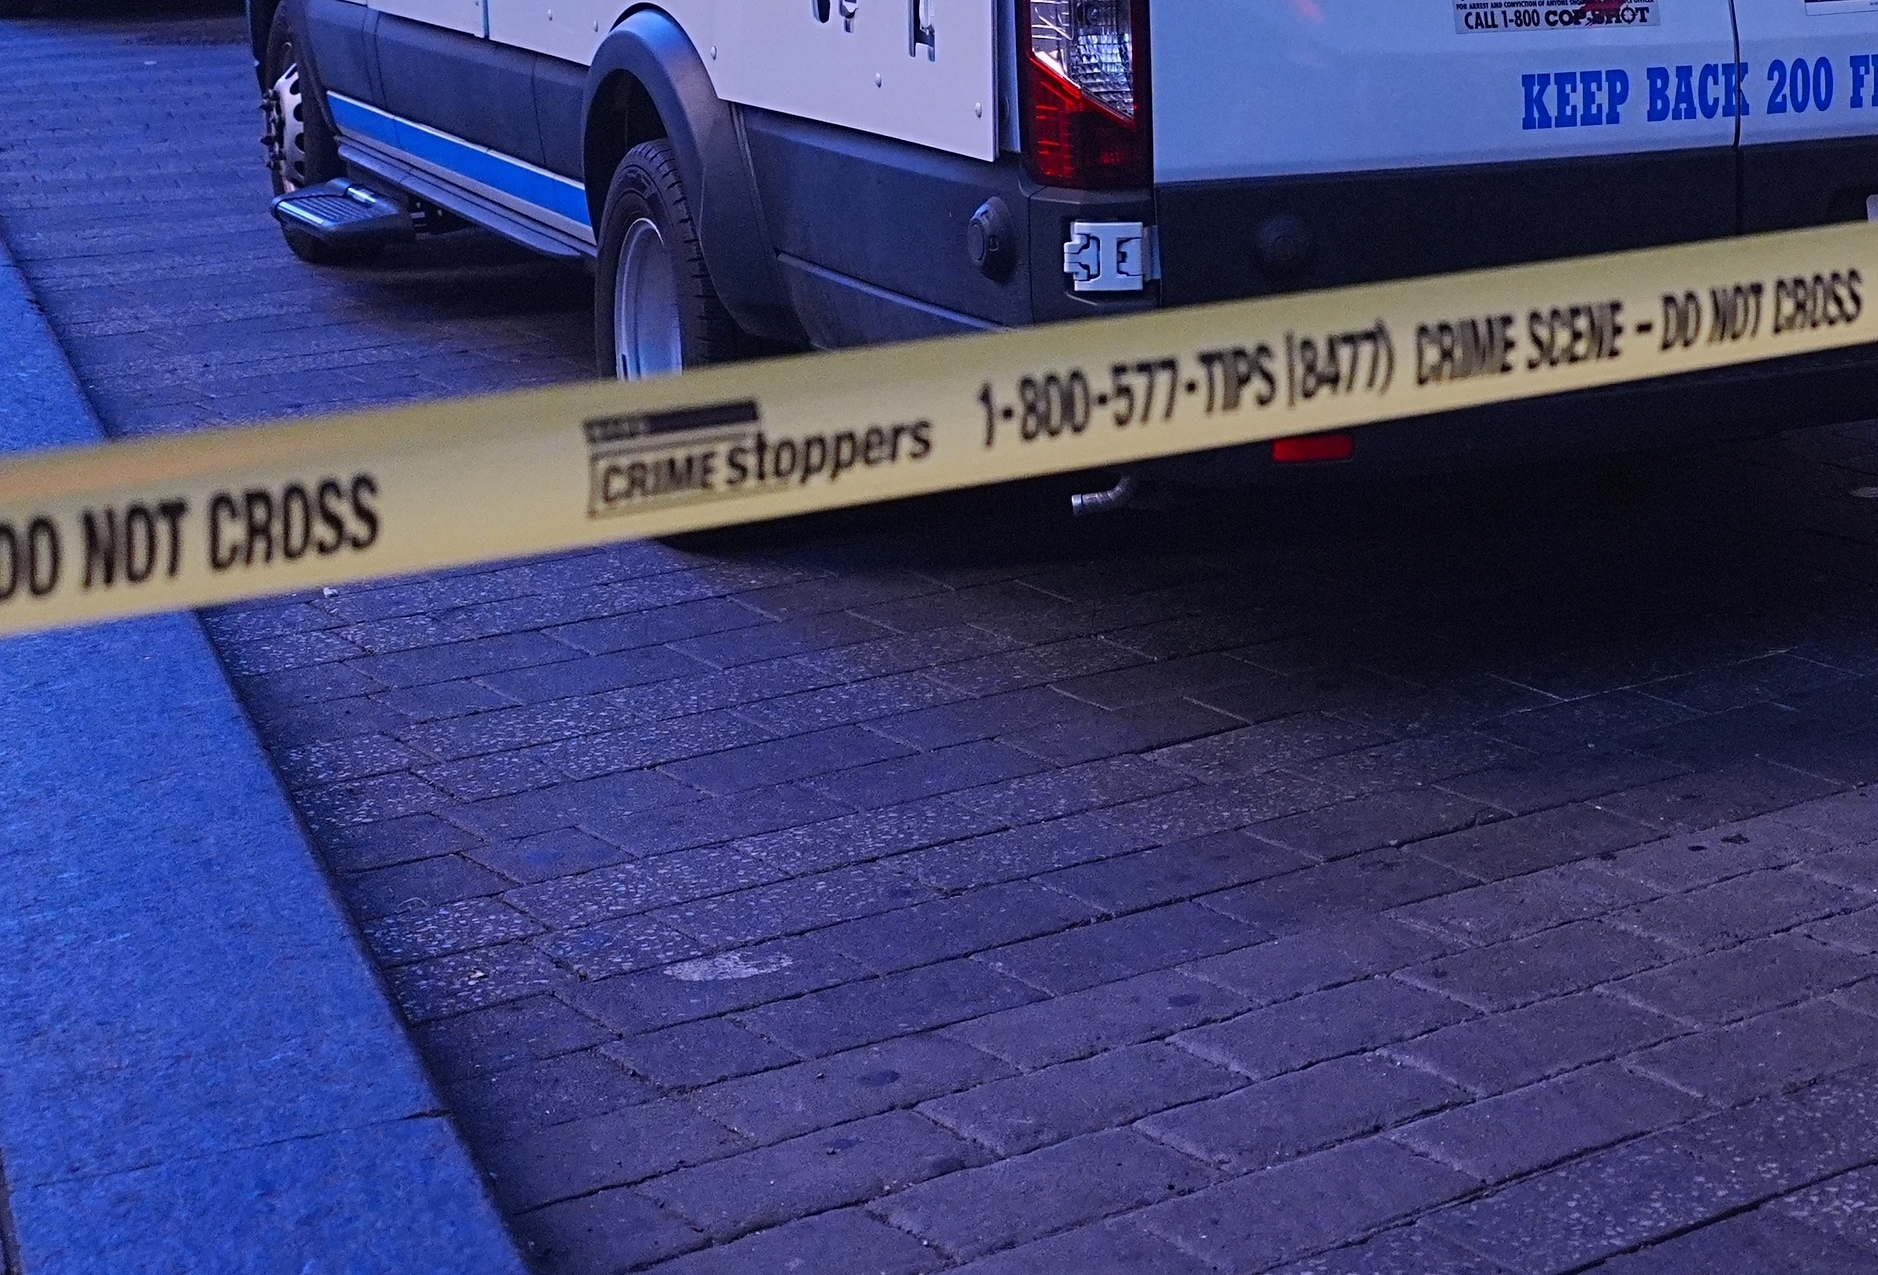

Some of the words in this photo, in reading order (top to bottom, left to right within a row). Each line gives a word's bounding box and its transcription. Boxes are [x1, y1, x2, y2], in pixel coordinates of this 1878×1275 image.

[1465, 11, 1498, 30] CALL
[1502, 9, 1541, 28] 1-800
[1469, 1, 1489, 10] ARREST
[1490, 1, 1502, 9] AND
[1504, 0, 1537, 8] CONVICTION
[1538, 0, 1545, 7] OF
[1522, 69, 1628, 130] KEEP
[1647, 61, 1750, 123] BACK
[1767, 56, 1834, 115] 200
[1414, 314, 1515, 385] CRIME
[1526, 300, 1624, 370] SCENE
[1660, 289, 1702, 352] DO
[1708, 282, 1765, 345] NOT
[1773, 268, 1864, 336] CROSS
[602, 451, 717, 505] CRIME
[0, 512, 62, 601] DO
[80, 497, 191, 592] NOT
[209, 472, 382, 573] CROSS
